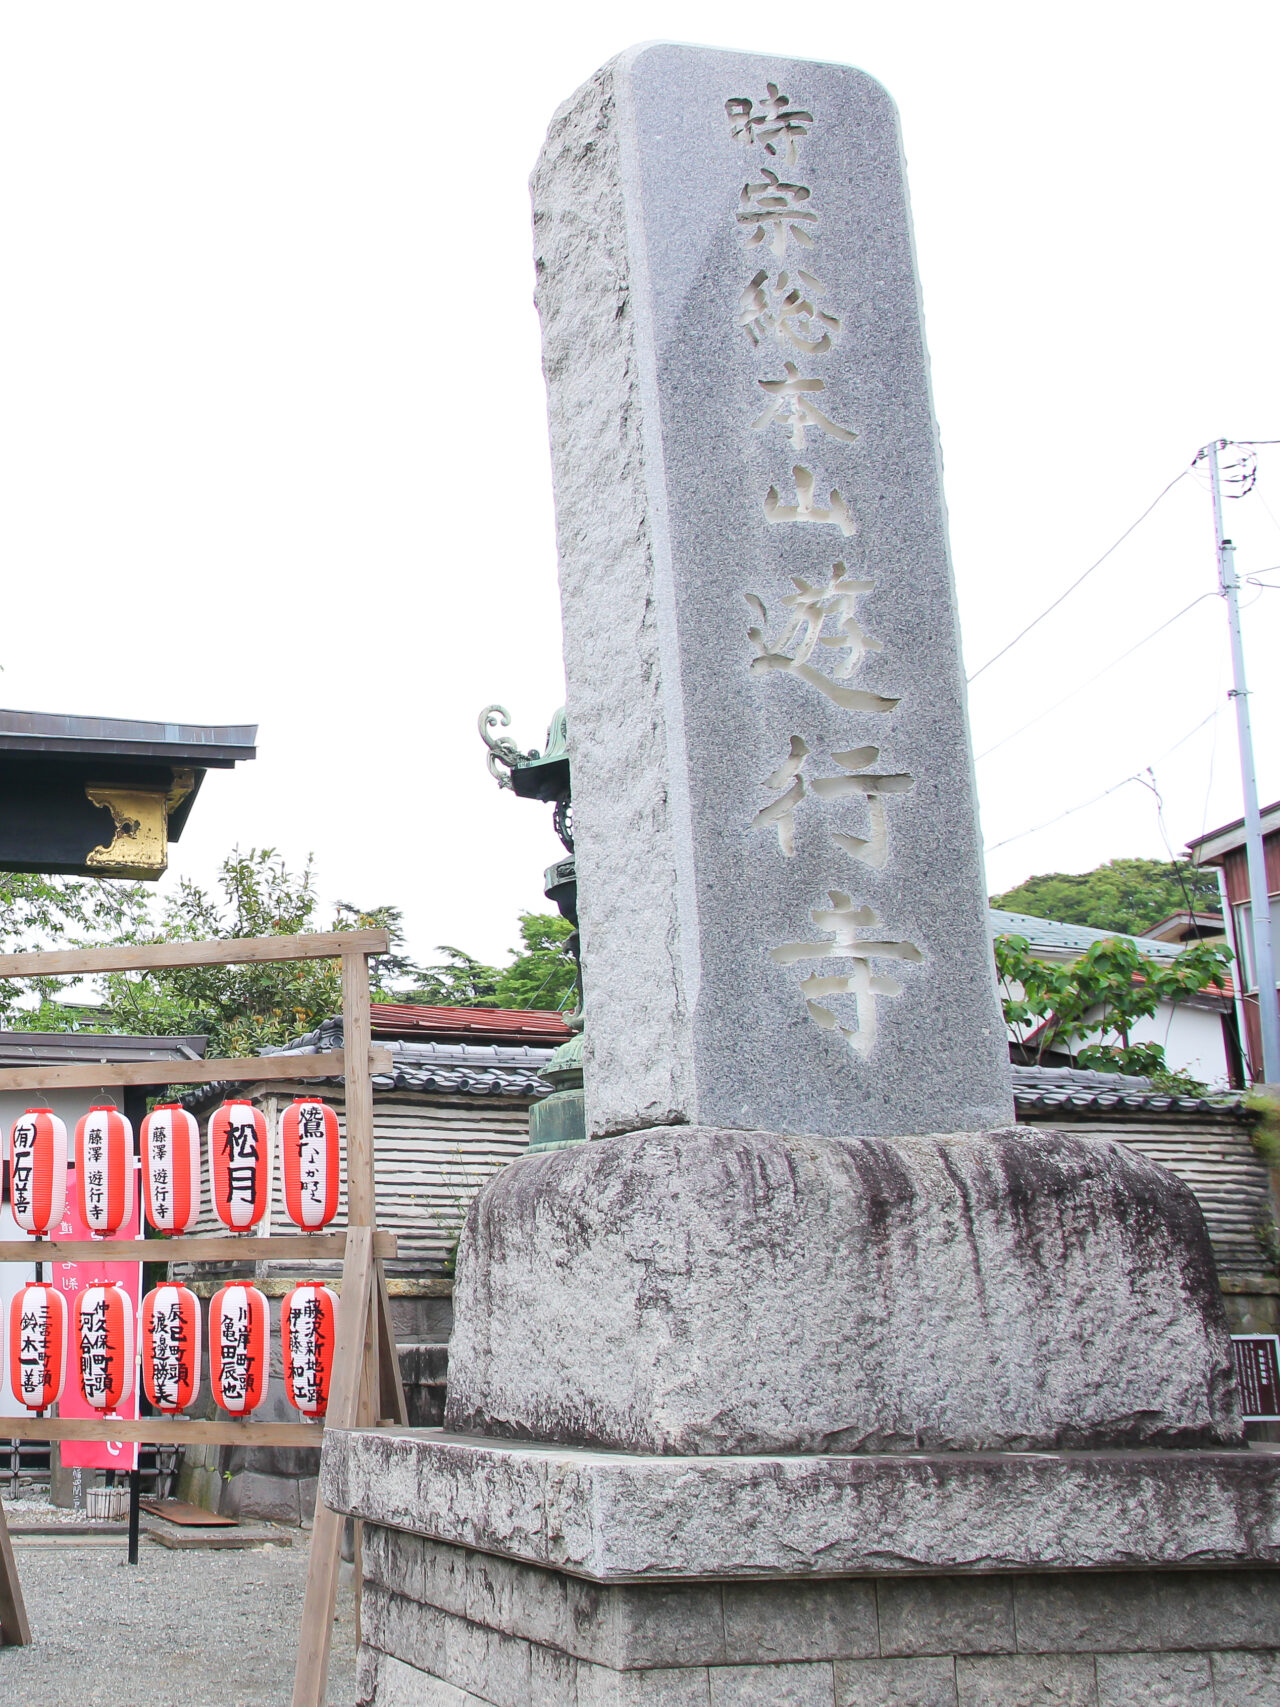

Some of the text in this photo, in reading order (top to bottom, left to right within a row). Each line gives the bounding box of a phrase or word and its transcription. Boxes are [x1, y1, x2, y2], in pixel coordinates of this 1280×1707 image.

[221, 1121, 259, 1204] 松月
[18, 1312, 40, 1393] 鈴木一善
[93, 1300, 115, 1394] 仲久保町頭
